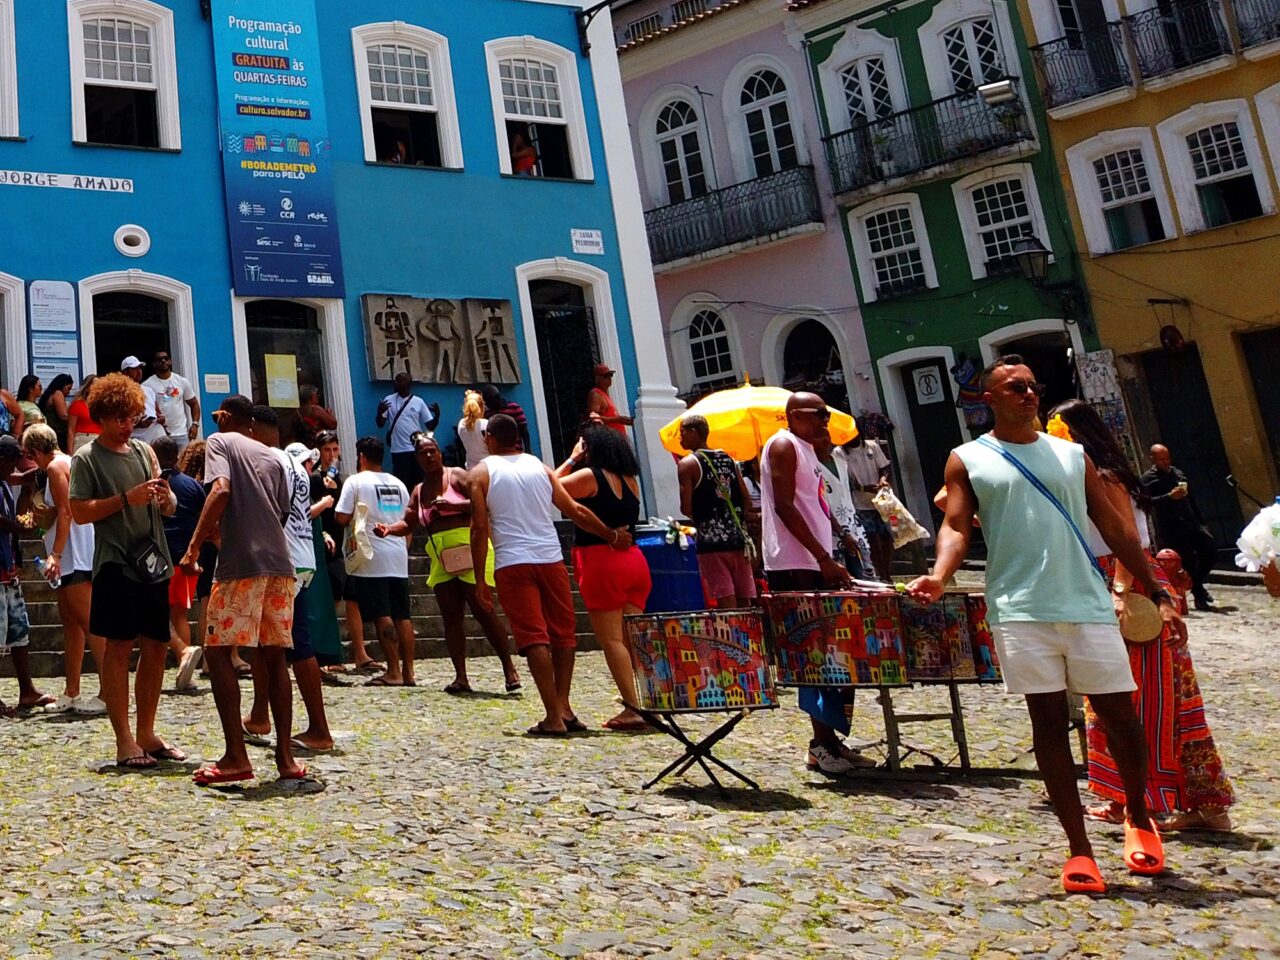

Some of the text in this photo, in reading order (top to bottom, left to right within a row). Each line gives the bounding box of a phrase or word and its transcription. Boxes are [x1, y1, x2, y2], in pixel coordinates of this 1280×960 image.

[228, 15, 302, 36] Programação
[245, 35, 288, 51] cultural
[235, 54, 304, 71] GRATUITA às
[233, 71, 307, 87] QUARTAS-FEIRAS
[234, 93, 270, 103] Programação
[239, 106, 307, 117] cultura.salvador.br
[73, 176, 132, 192] AMADO
[280, 211, 295, 219] CCR
[307, 275, 334, 284] BRASIL
